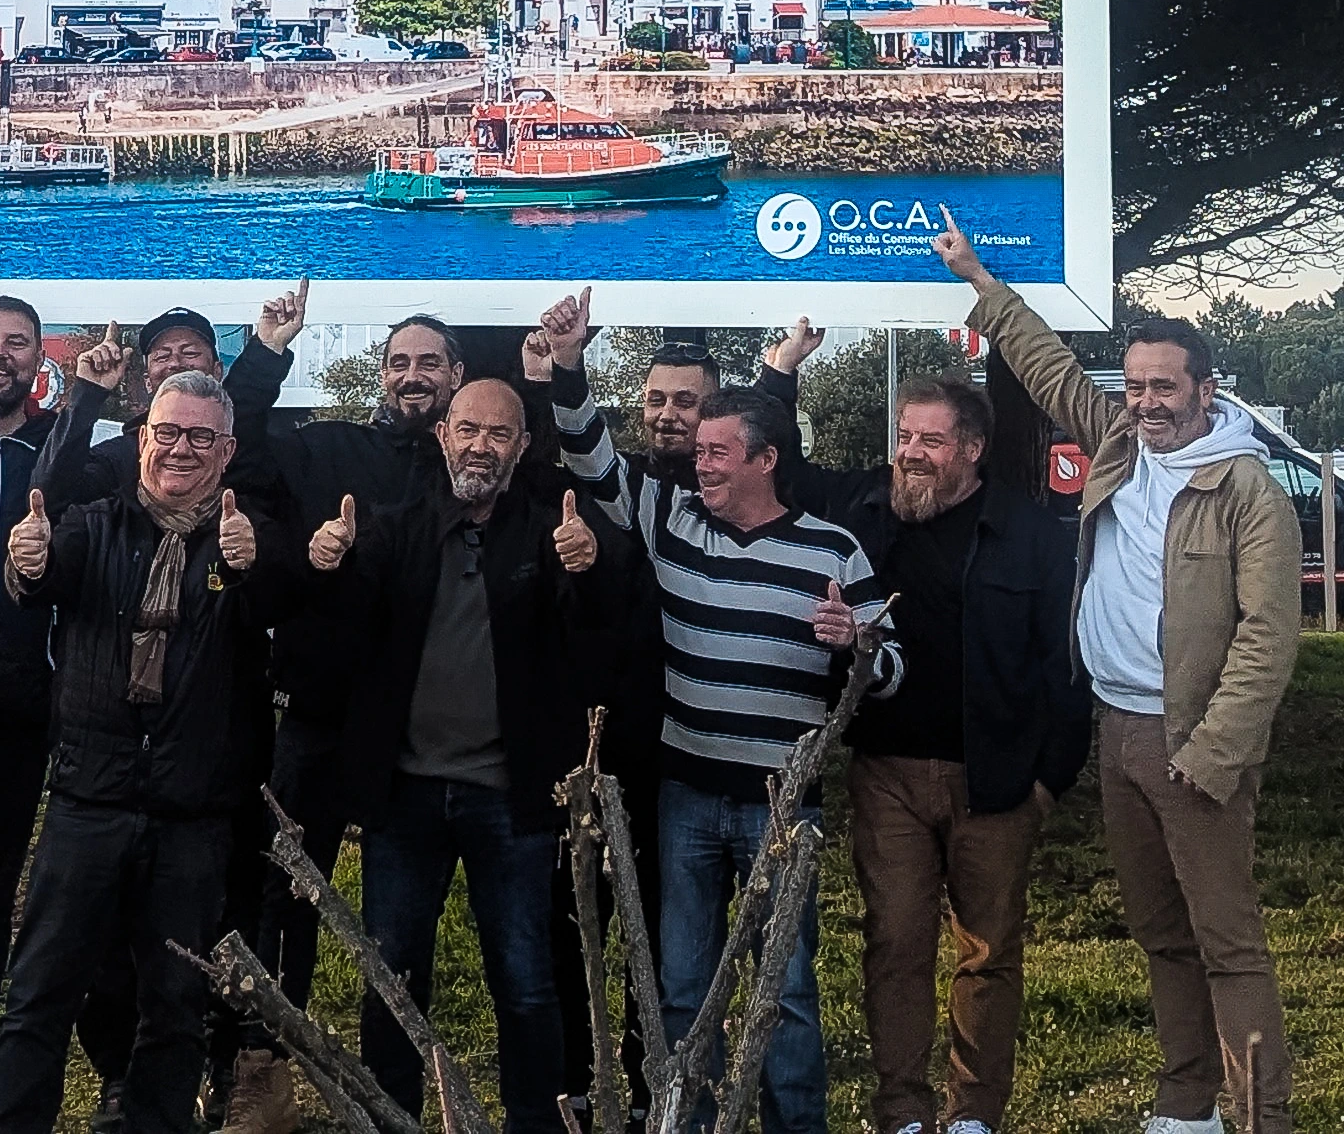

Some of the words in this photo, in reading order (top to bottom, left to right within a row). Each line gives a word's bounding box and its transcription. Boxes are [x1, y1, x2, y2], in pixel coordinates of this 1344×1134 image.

[828, 232, 862, 245] Office
[865, 232, 880, 245] du
[881, 232, 939, 245] Commerc
[973, 233, 1032, 246] l'Artisanat
[828, 244, 847, 256] Les
[848, 244, 882, 256] Sables
